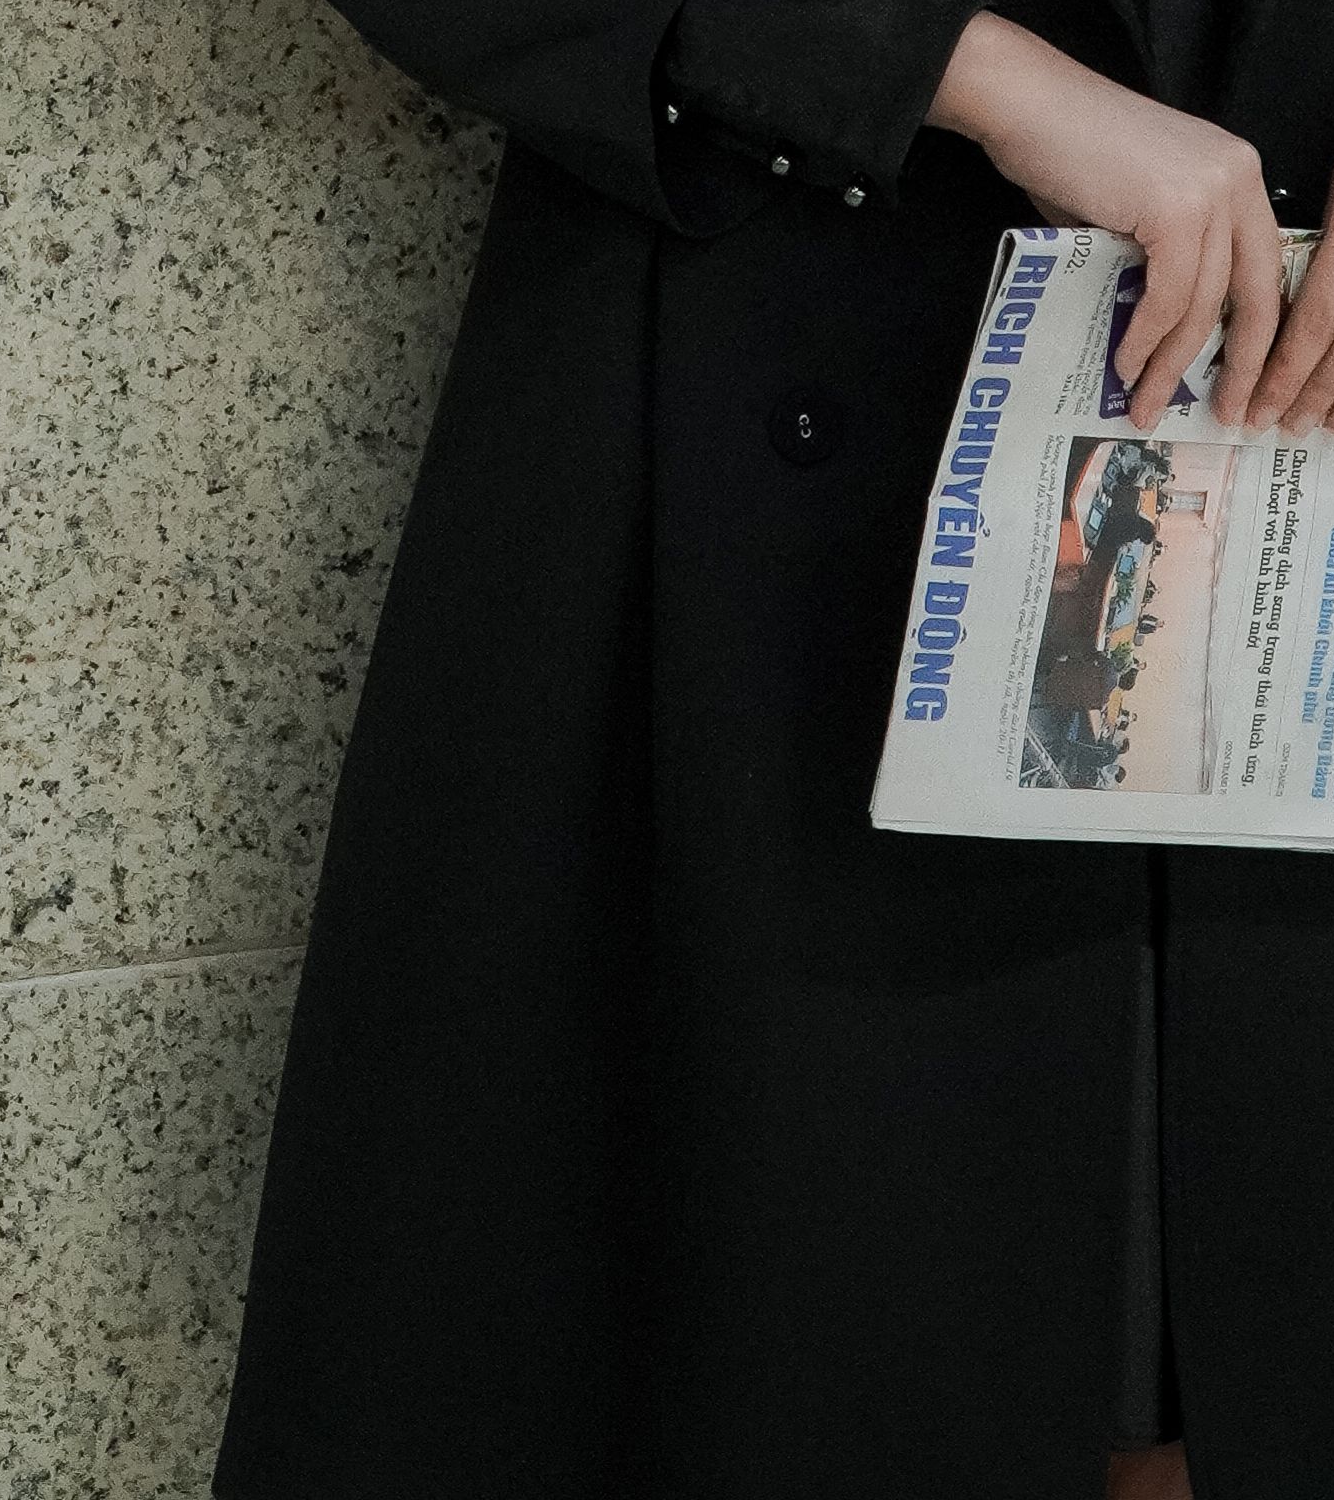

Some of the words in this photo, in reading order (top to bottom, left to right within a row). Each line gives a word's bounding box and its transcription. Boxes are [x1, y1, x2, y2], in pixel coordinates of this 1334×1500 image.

[983, 255, 1052, 364] RỊCH
[931, 377, 1009, 567] CHUYỂN
[1273, 448, 1289, 477] linh
[1287, 450, 1307, 506] Chuyển
[1267, 483, 1285, 515] hoạt
[1264, 520, 1277, 542] với
[1278, 511, 1299, 555] chống
[1259, 548, 1275, 576] tình
[1275, 560, 1292, 590] dịch
[1253, 582, 1271, 615] hình
[1266, 596, 1283, 631] sang
[905, 580, 969, 721] ĐỘNG
[1246, 621, 1261, 648] mới
[1258, 637, 1280, 675] trạng
[1255, 681, 1272, 708] thái
[1250, 714, 1266, 749] thích
